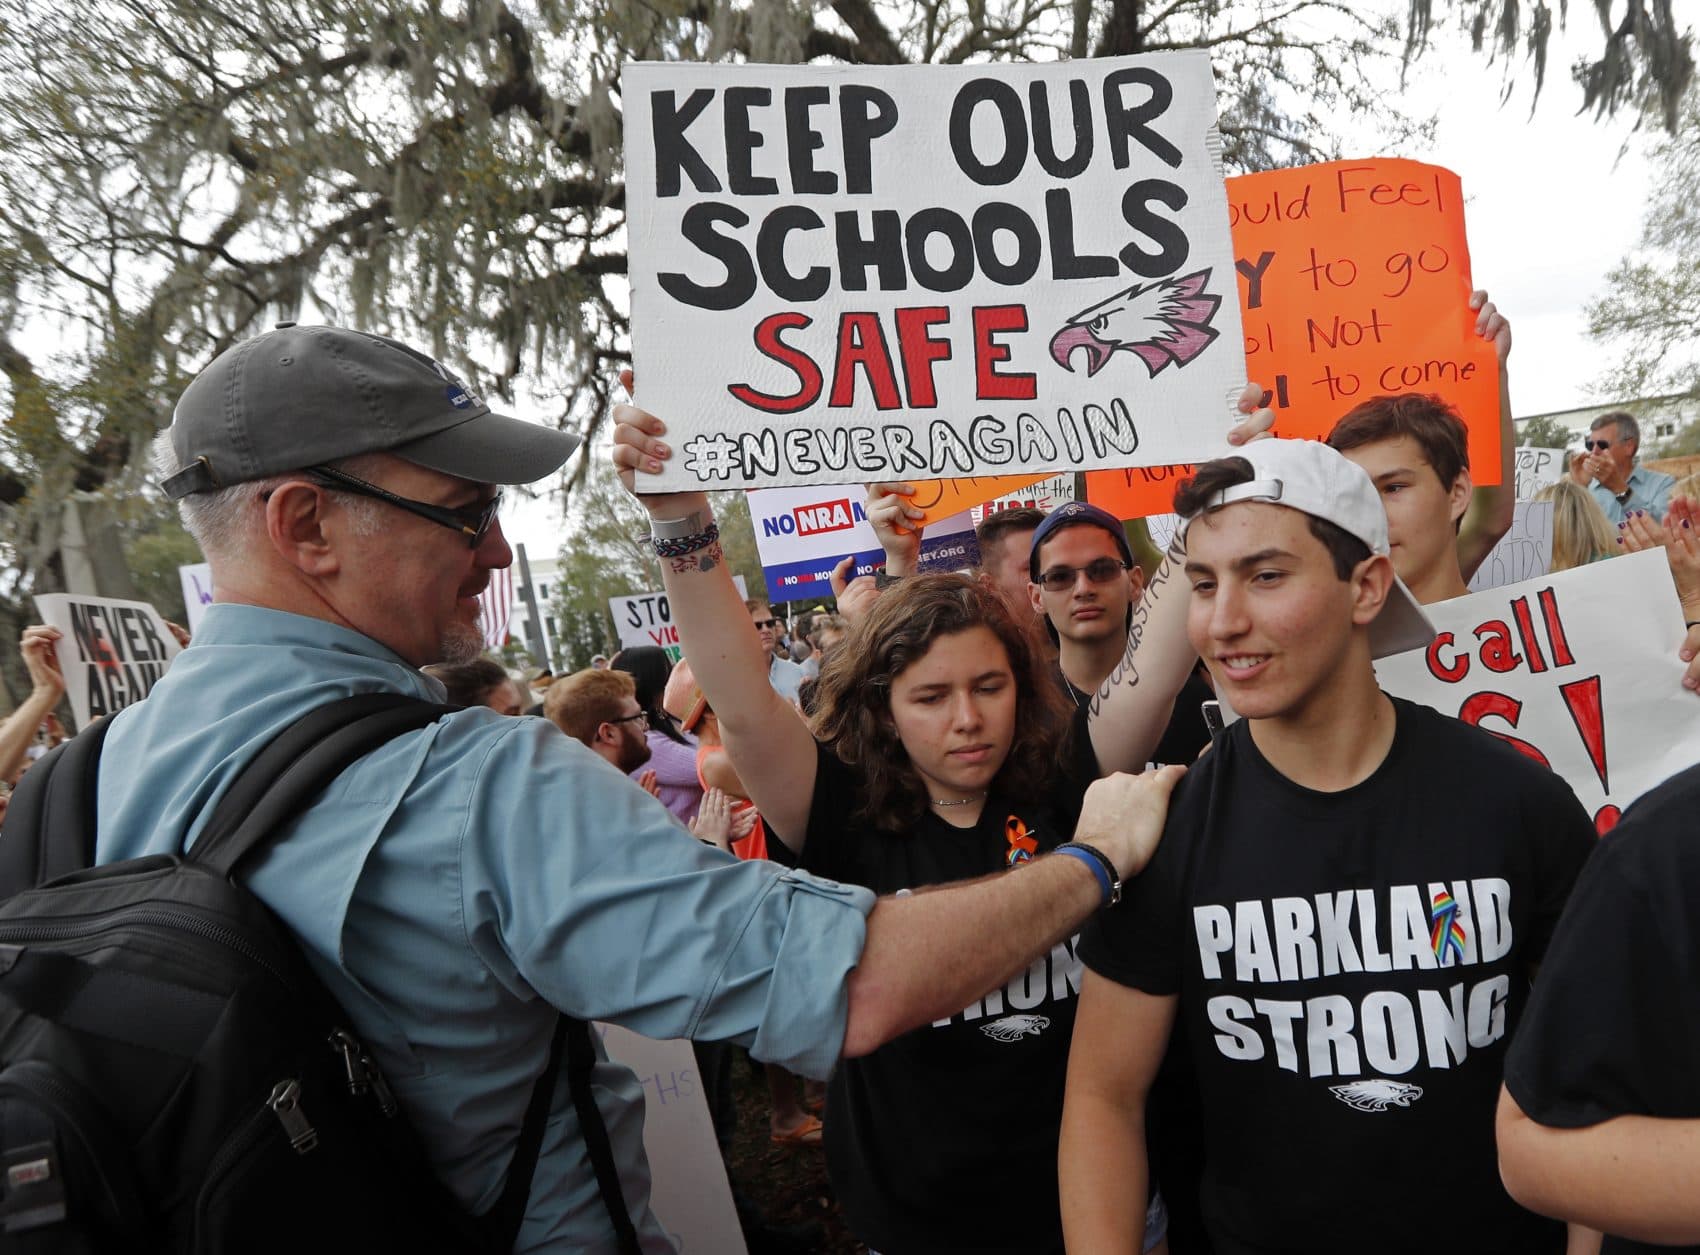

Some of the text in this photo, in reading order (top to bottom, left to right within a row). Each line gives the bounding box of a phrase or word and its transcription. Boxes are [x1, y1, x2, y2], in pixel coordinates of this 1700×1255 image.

[650, 66, 1182, 197] KEEP OUR
[1337, 167, 1444, 213] Feel
[657, 178, 1190, 310] SCHOOLS
[1300, 247, 1357, 291] to
[1383, 244, 1449, 298] go
[728, 303, 1038, 414] SAFE
[1306, 308, 1392, 353] Not
[1312, 365, 1361, 400] to
[1380, 358, 1476, 392] come
[684, 398, 1139, 480] #NEVERAGAIN
[762, 514, 796, 537] NO
[797, 503, 850, 532] NRA
[1050, 478, 1073, 499] the
[69, 602, 167, 662] NEVER
[1425, 586, 1576, 683] call
[1193, 878, 1513, 982] PARKLAND
[1206, 974, 1510, 1078] STRONG
